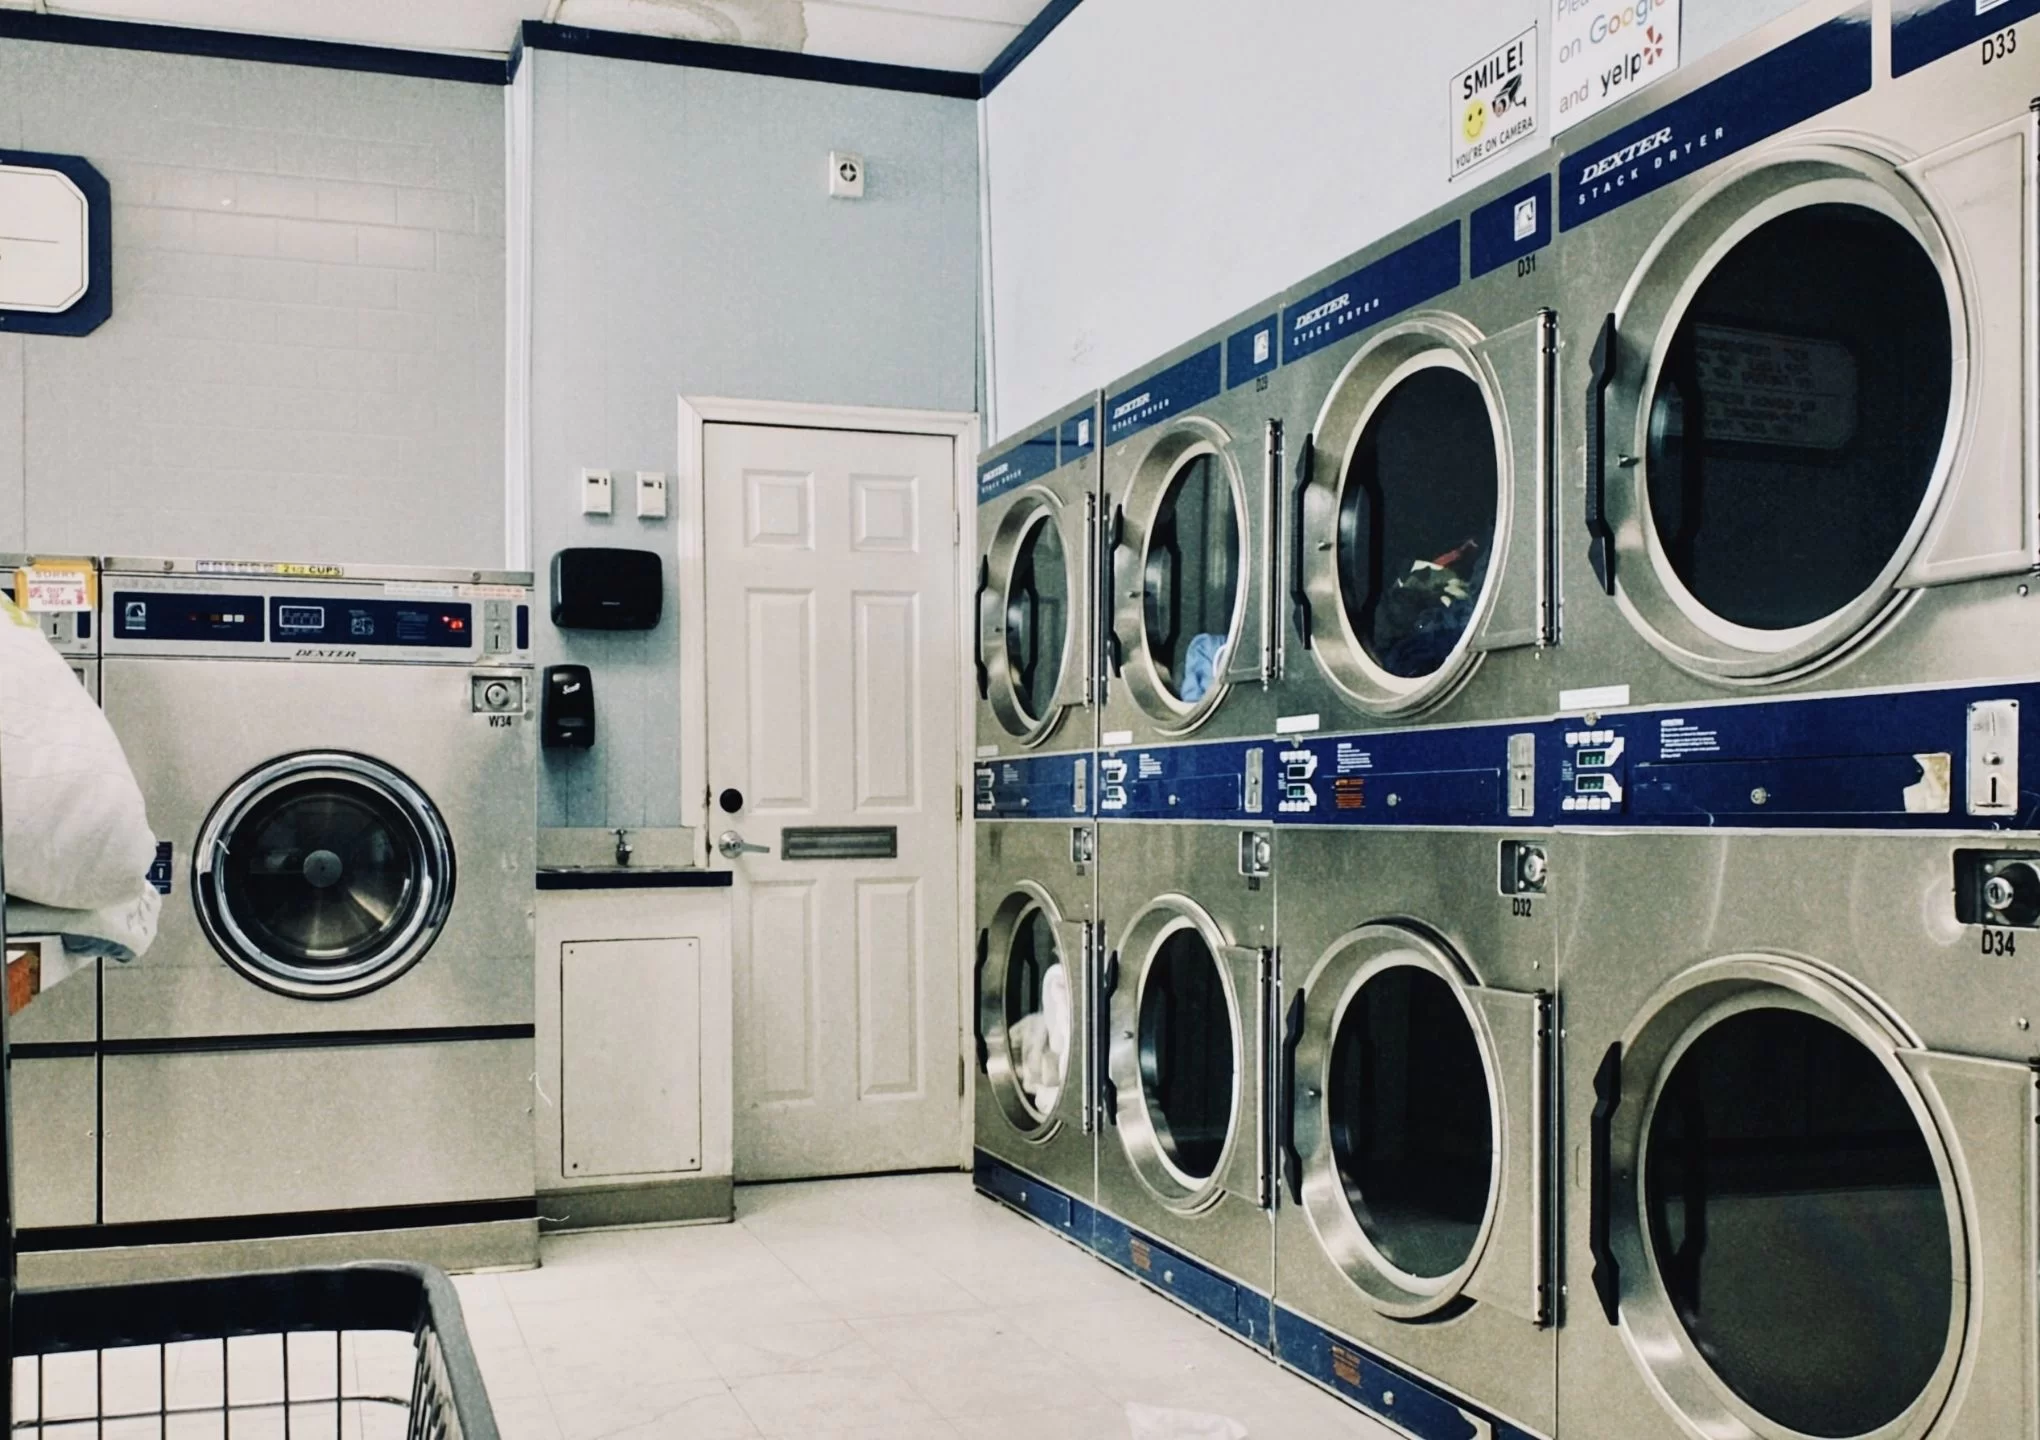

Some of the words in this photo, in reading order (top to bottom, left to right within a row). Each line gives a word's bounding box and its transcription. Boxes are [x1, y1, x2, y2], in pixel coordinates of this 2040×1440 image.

[1560, 38, 1581, 64] on
[1982, 28, 2017, 66] D33
[1463, 40, 1524, 100] SMILE!
[1560, 80, 1589, 114] and
[1601, 52, 1642, 97] yelp
[1456, 143, 1482, 168] YOU'RE
[1486, 136, 1497, 153] ON
[1500, 116, 1533, 145] CAMERA
[1580, 126, 1673, 185] DEXTER
[1578, 168, 1638, 205] STACK
[1654, 127, 1724, 169] DRYER
[1518, 254, 1536, 278] D31
[1293, 321, 1331, 346] STACK
[1338, 298, 1380, 325] DRYER
[1294, 293, 1351, 331] DEXTER
[308, 565, 340, 576] CUPS
[295, 649, 357, 659] DEXTER
[488, 715, 512, 727] W34
[1512, 898, 1532, 918] D32
[1981, 929, 2016, 957] D34
